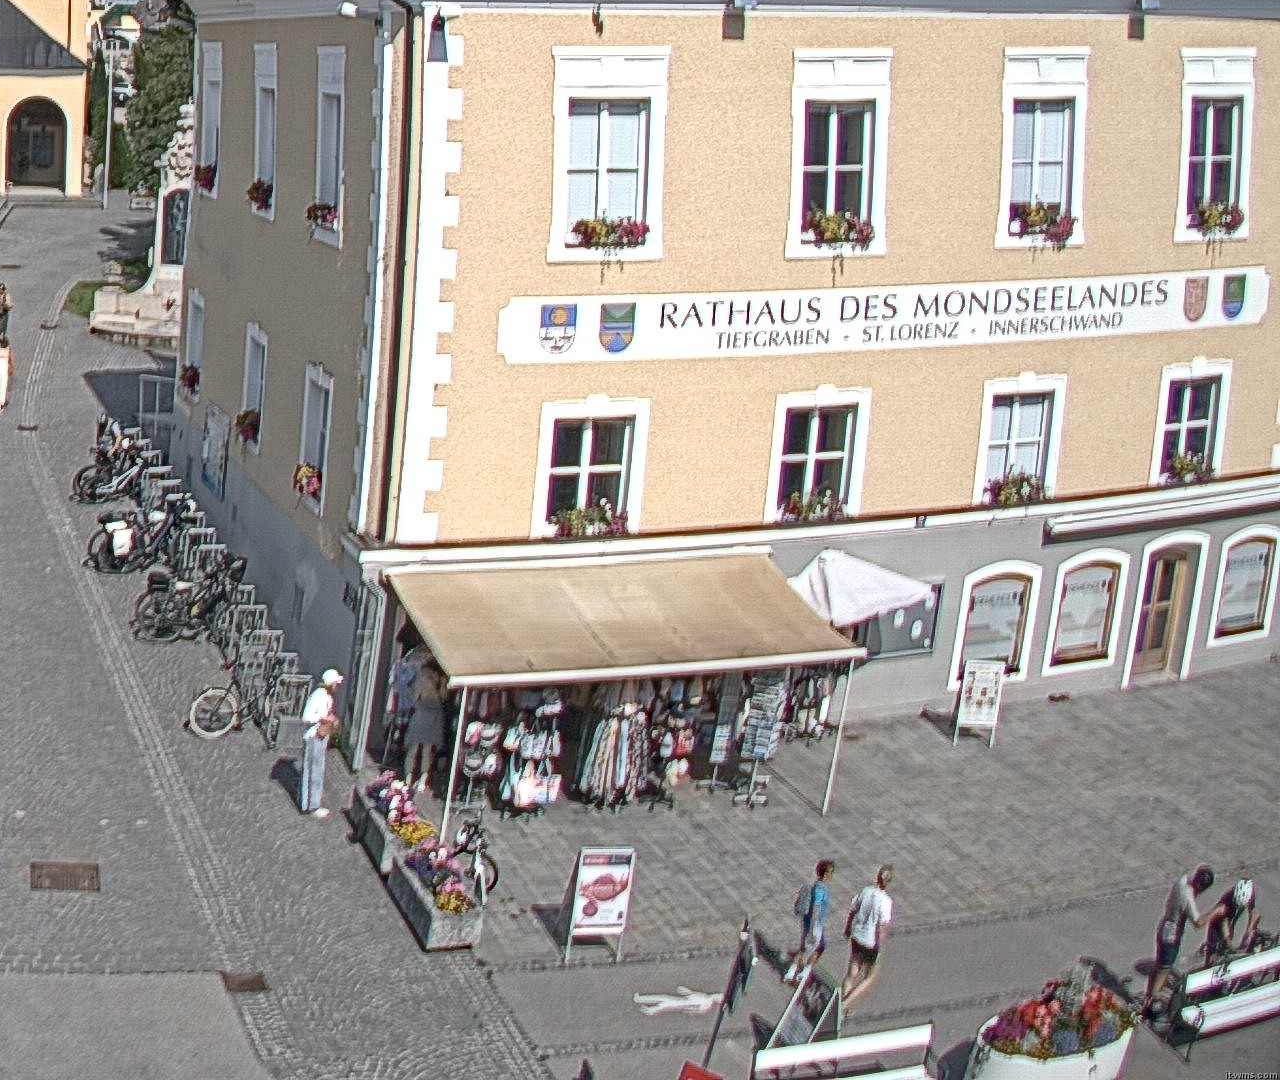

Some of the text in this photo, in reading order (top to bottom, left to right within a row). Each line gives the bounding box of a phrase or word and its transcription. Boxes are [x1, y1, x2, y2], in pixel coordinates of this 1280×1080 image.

[659, 279, 1169, 328] RATHAUS DES MONDSEELANDES
[716, 328, 830, 350] TIEFGRABEN
[890, 320, 960, 342] LORENZ
[988, 311, 1123, 337] INNERSCHWAND
